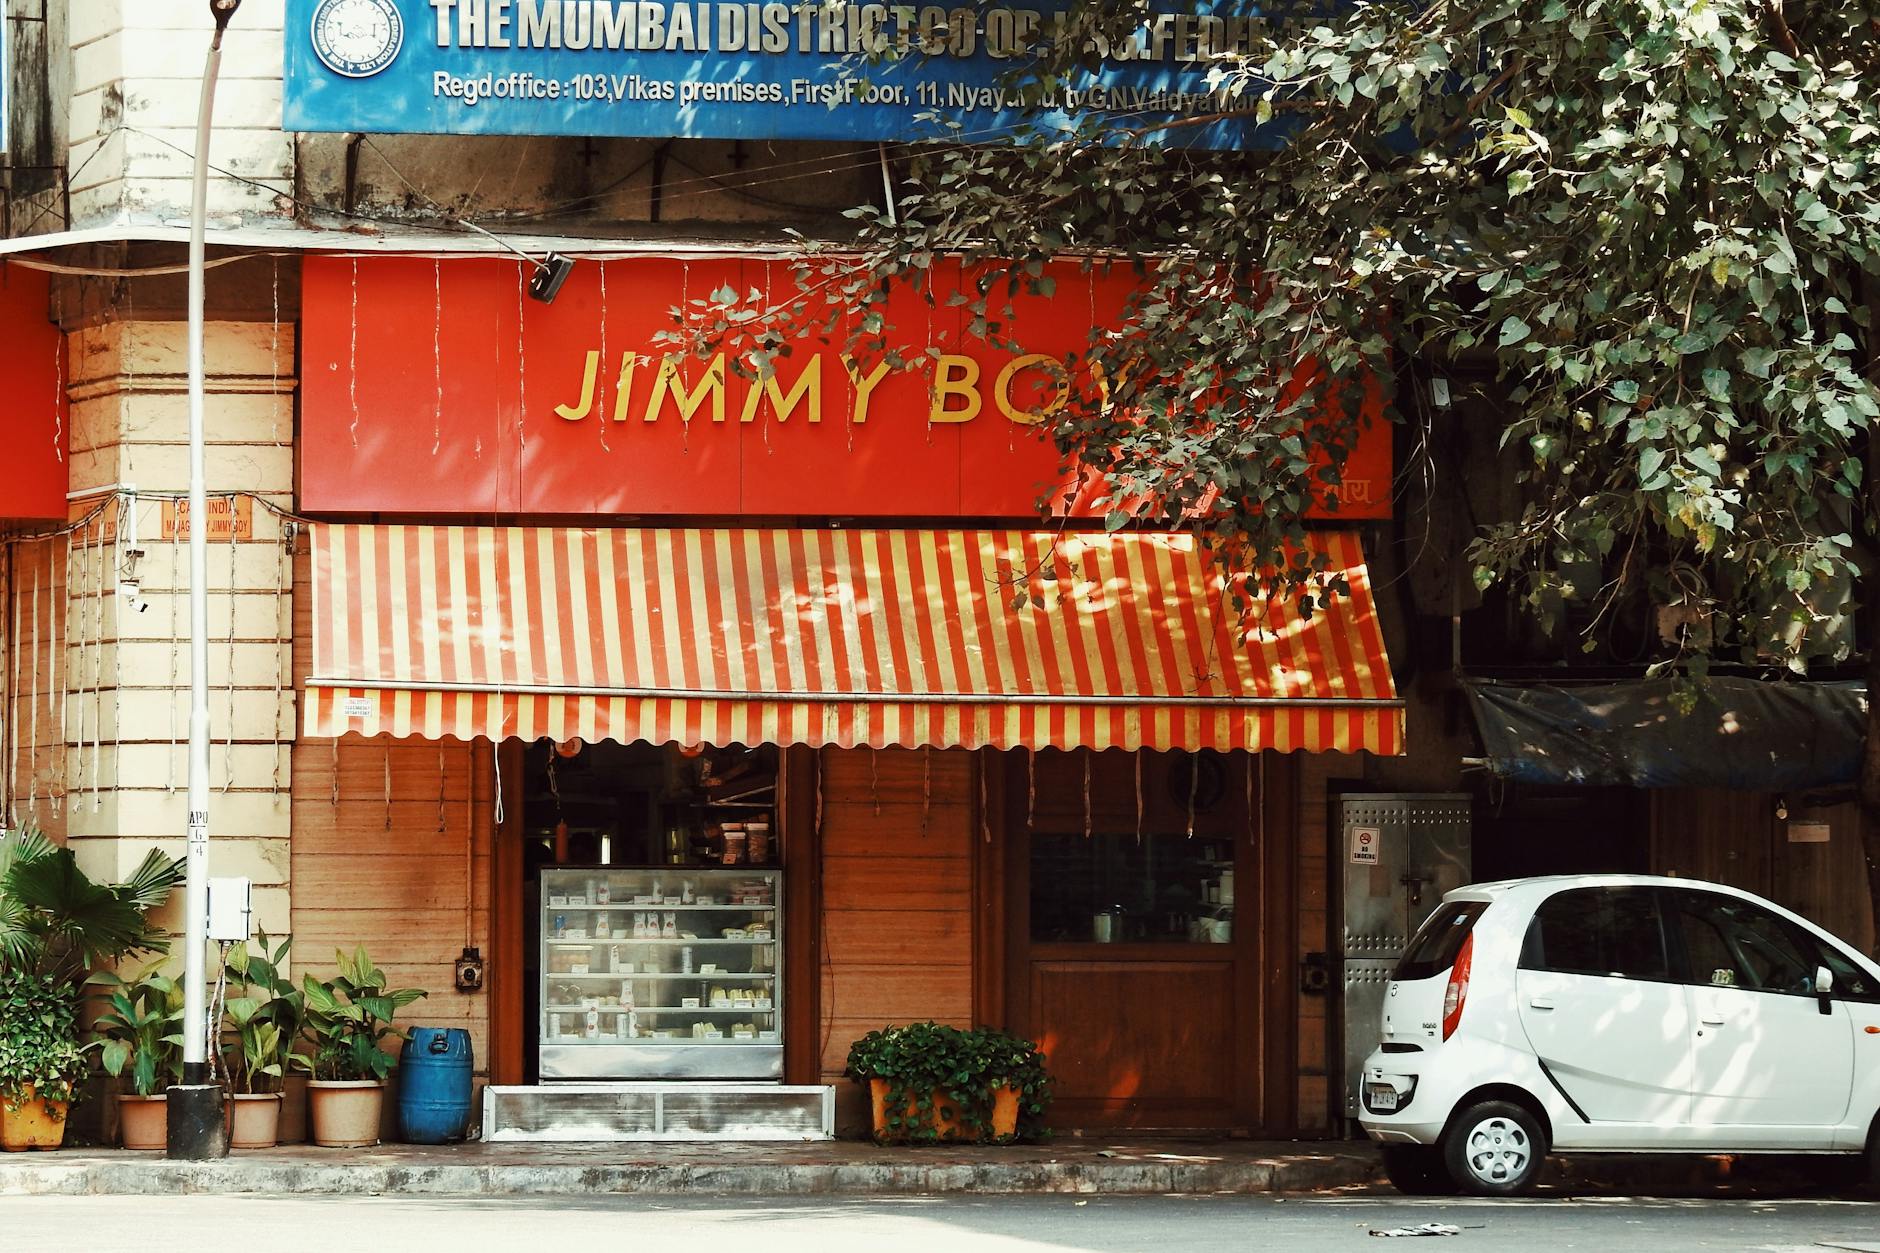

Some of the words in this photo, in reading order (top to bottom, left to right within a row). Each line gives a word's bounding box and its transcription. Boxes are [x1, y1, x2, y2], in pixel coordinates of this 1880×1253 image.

[430, 0, 511, 48] THE
[517, 0, 709, 51] MUMBAI
[718, 2, 916, 54] DISTRICT
[433, 70, 492, 105] Regd
[553, 350, 897, 424] JIMMY
[929, 353, 1140, 424] BOY
